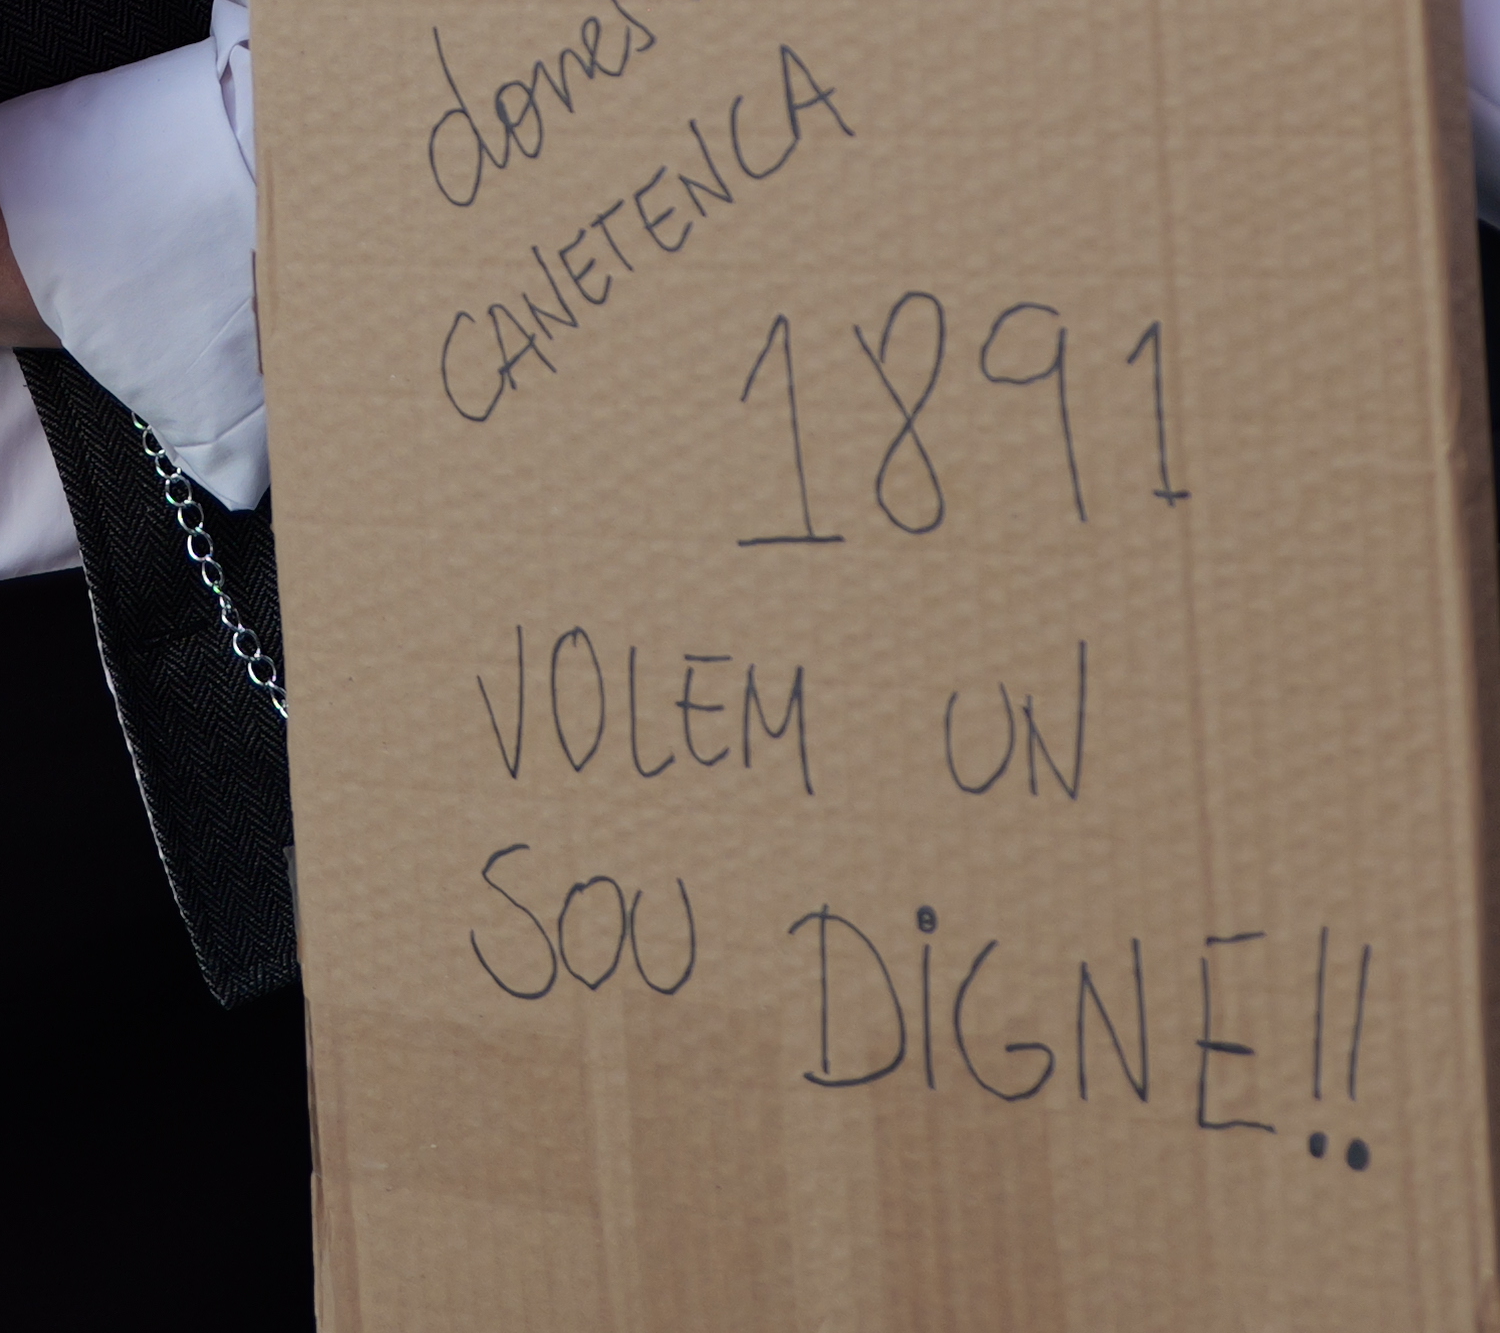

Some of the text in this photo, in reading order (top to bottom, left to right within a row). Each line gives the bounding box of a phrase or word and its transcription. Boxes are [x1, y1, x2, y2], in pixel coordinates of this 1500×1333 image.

[440, 44, 855, 421] CANETENCA
[737, 291, 1192, 546] 1891
[477, 624, 1085, 800] VOLEM UN
[470, 843, 697, 1000] SOU
